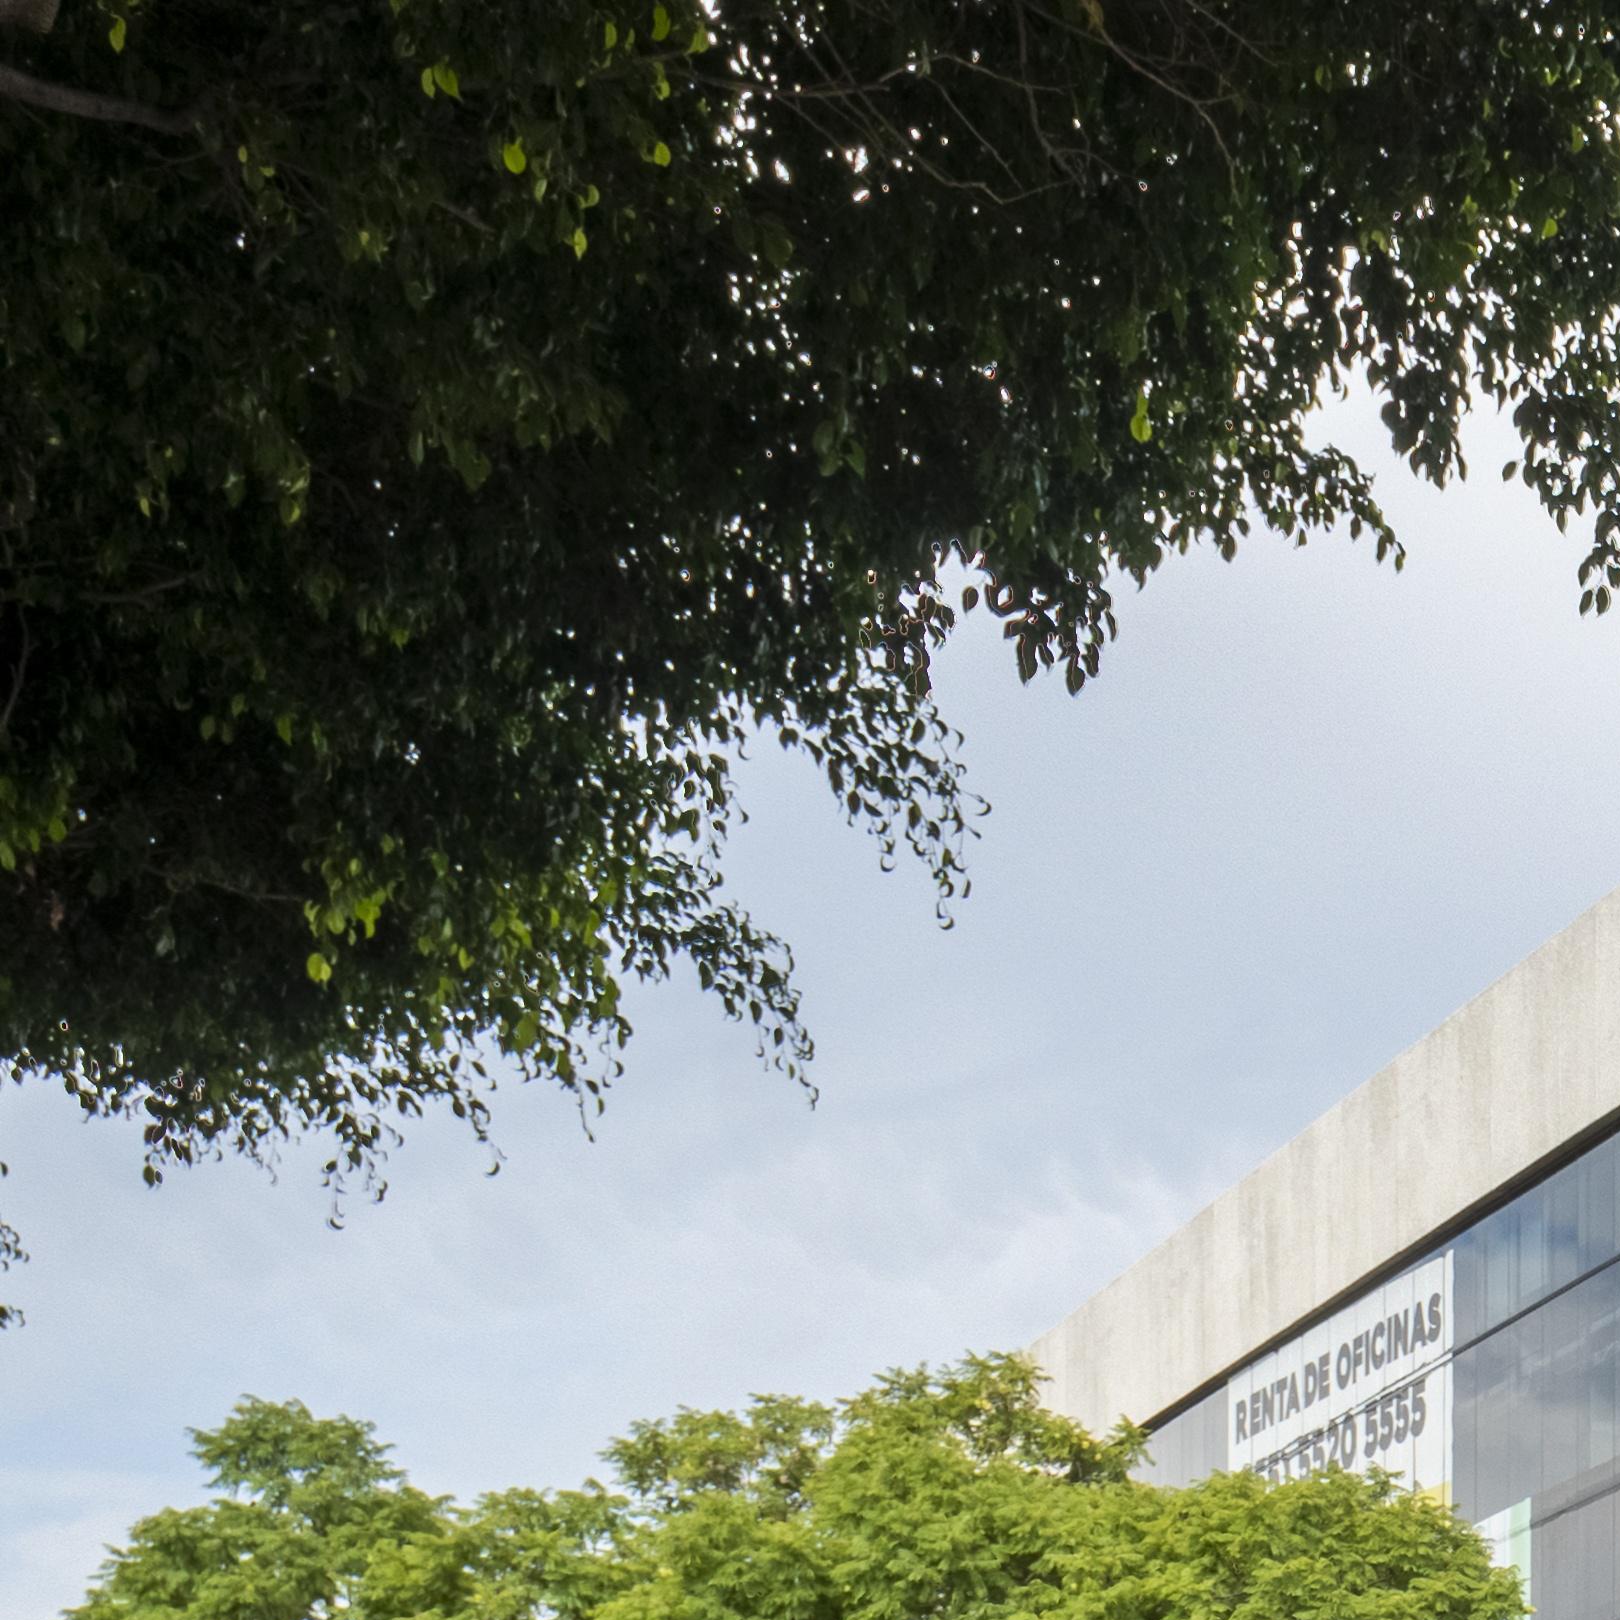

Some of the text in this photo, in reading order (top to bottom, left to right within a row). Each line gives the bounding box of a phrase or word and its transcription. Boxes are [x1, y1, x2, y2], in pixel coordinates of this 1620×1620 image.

[1235, 1292, 1442, 1445] RENTA DE OFICINAS
[1364, 1377, 1427, 1459] 5555
